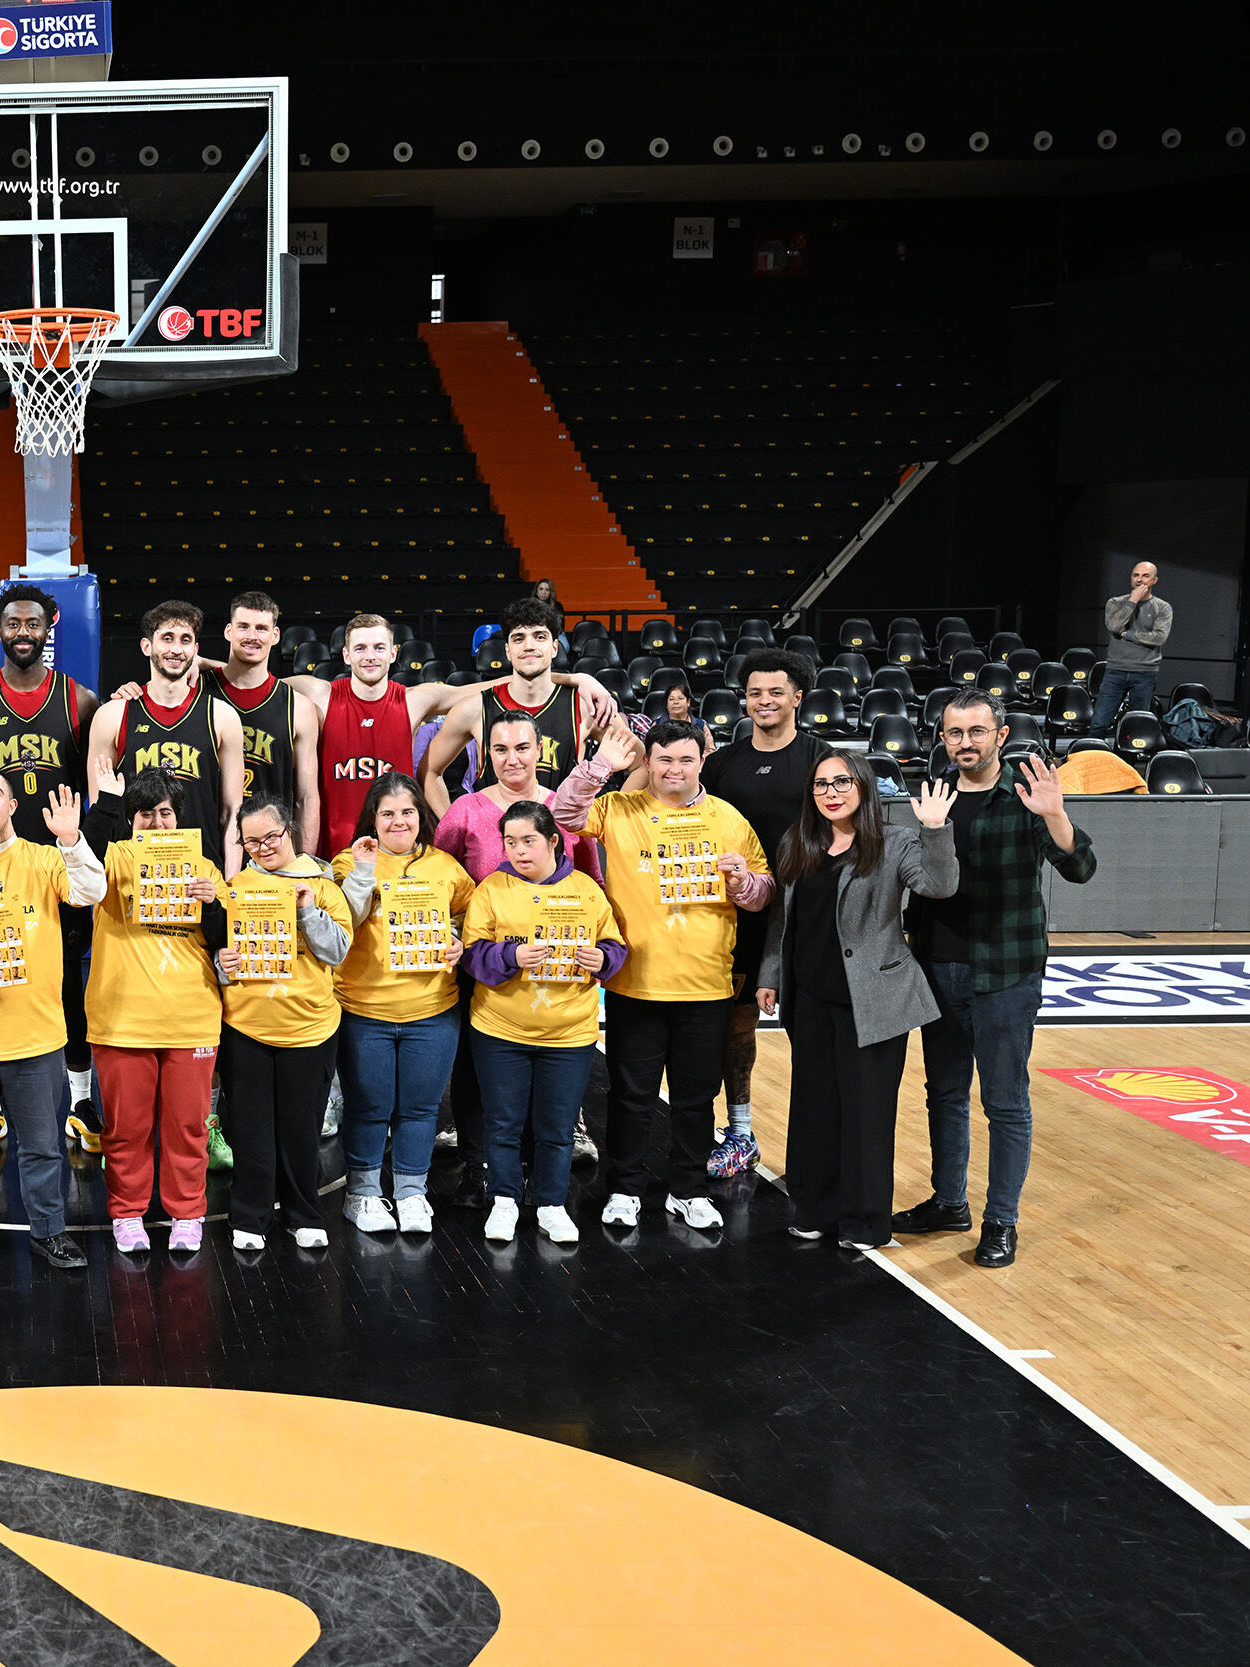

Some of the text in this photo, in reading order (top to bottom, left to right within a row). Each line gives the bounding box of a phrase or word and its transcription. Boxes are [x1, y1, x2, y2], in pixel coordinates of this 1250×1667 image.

[290, 245, 324, 256] BLOK
[676, 240, 710, 250] BLOK
[196, 308, 263, 338] TBF
[242, 725, 276, 765] SK
[134, 741, 202, 779] MSK
[334, 756, 395, 781] MSK
[23, 771, 38, 795] 0
